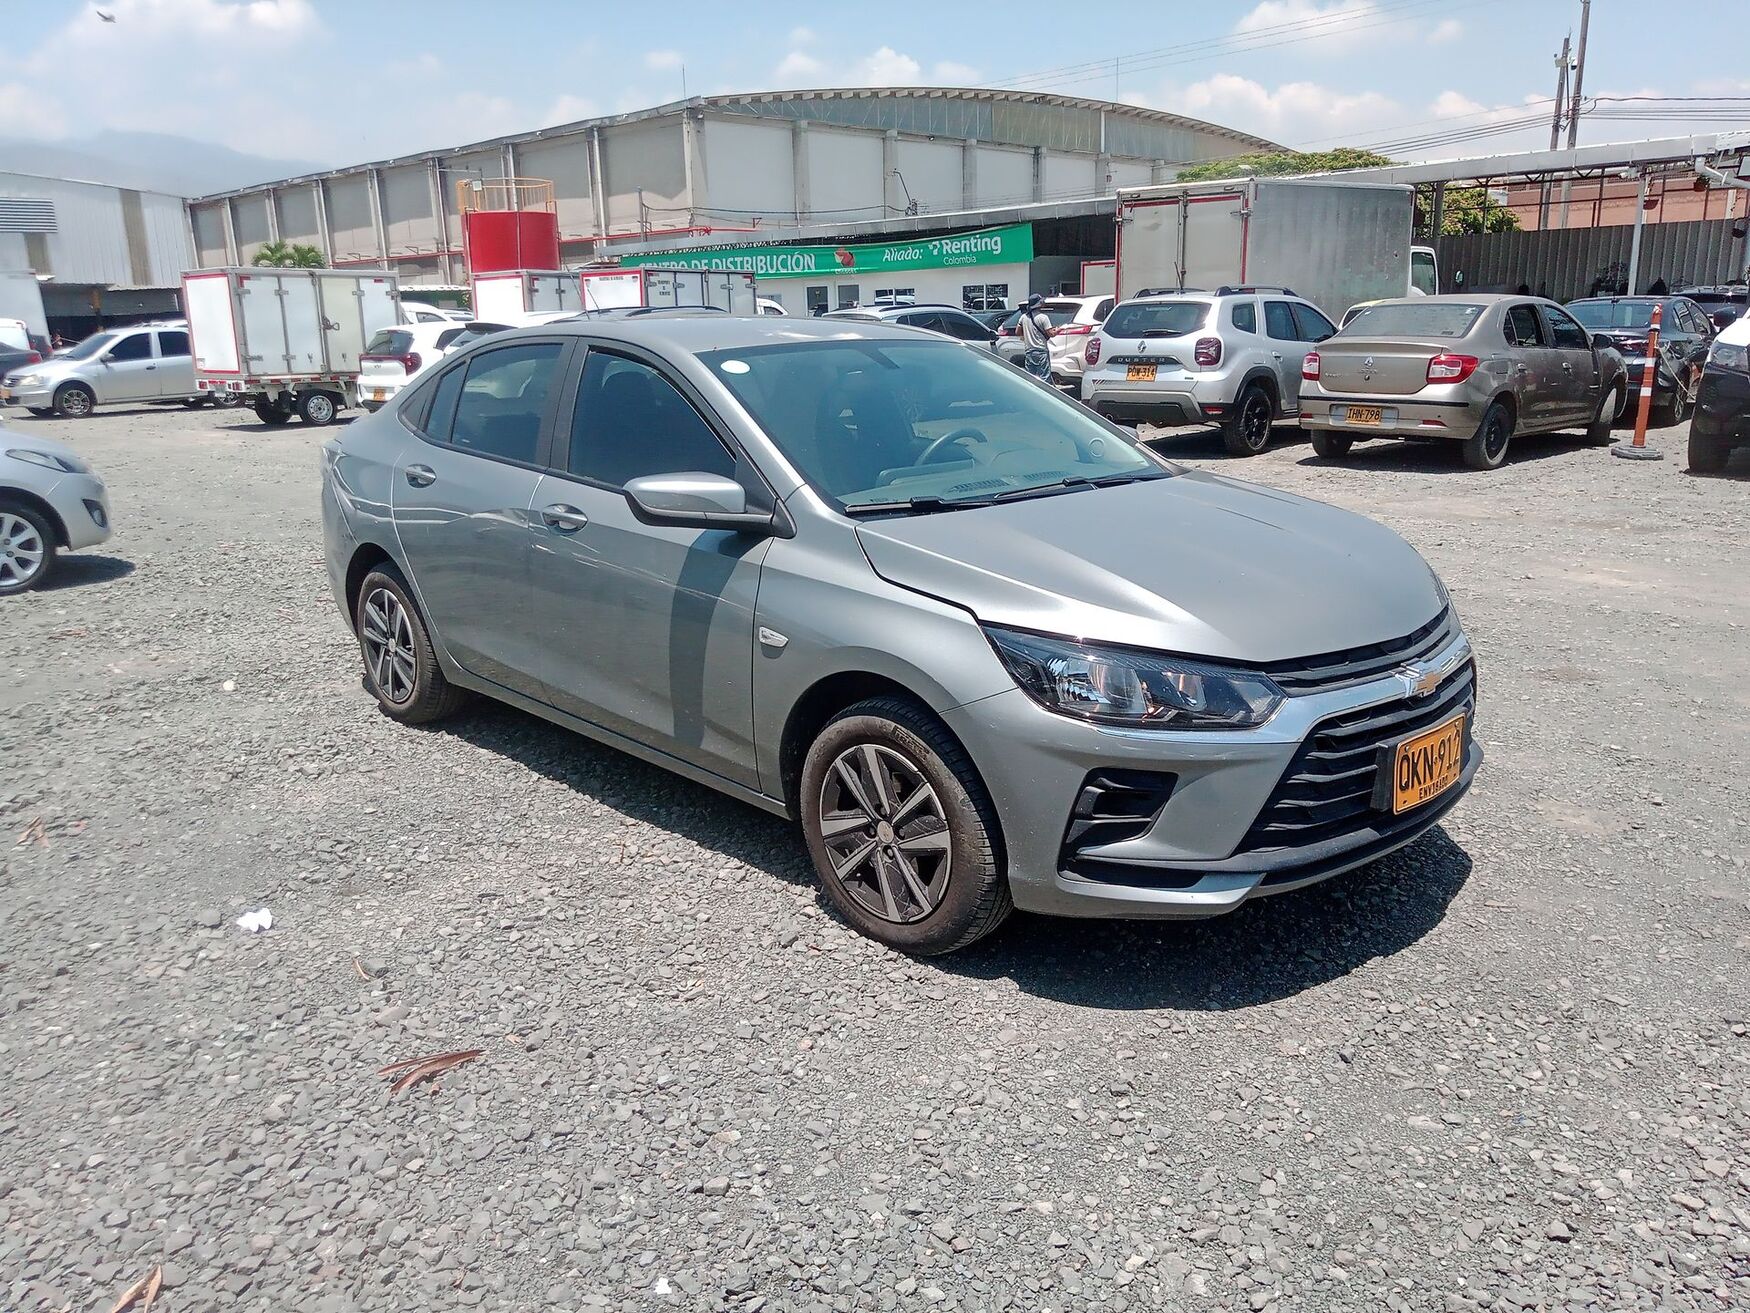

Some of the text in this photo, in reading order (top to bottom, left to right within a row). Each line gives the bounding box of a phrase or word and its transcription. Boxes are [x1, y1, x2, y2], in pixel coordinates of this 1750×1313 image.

[882, 234, 1002, 263] Aliado: Renting
[711, 252, 816, 274] DISTRIBUCIÓN
[943, 254, 977, 266] Colombia
